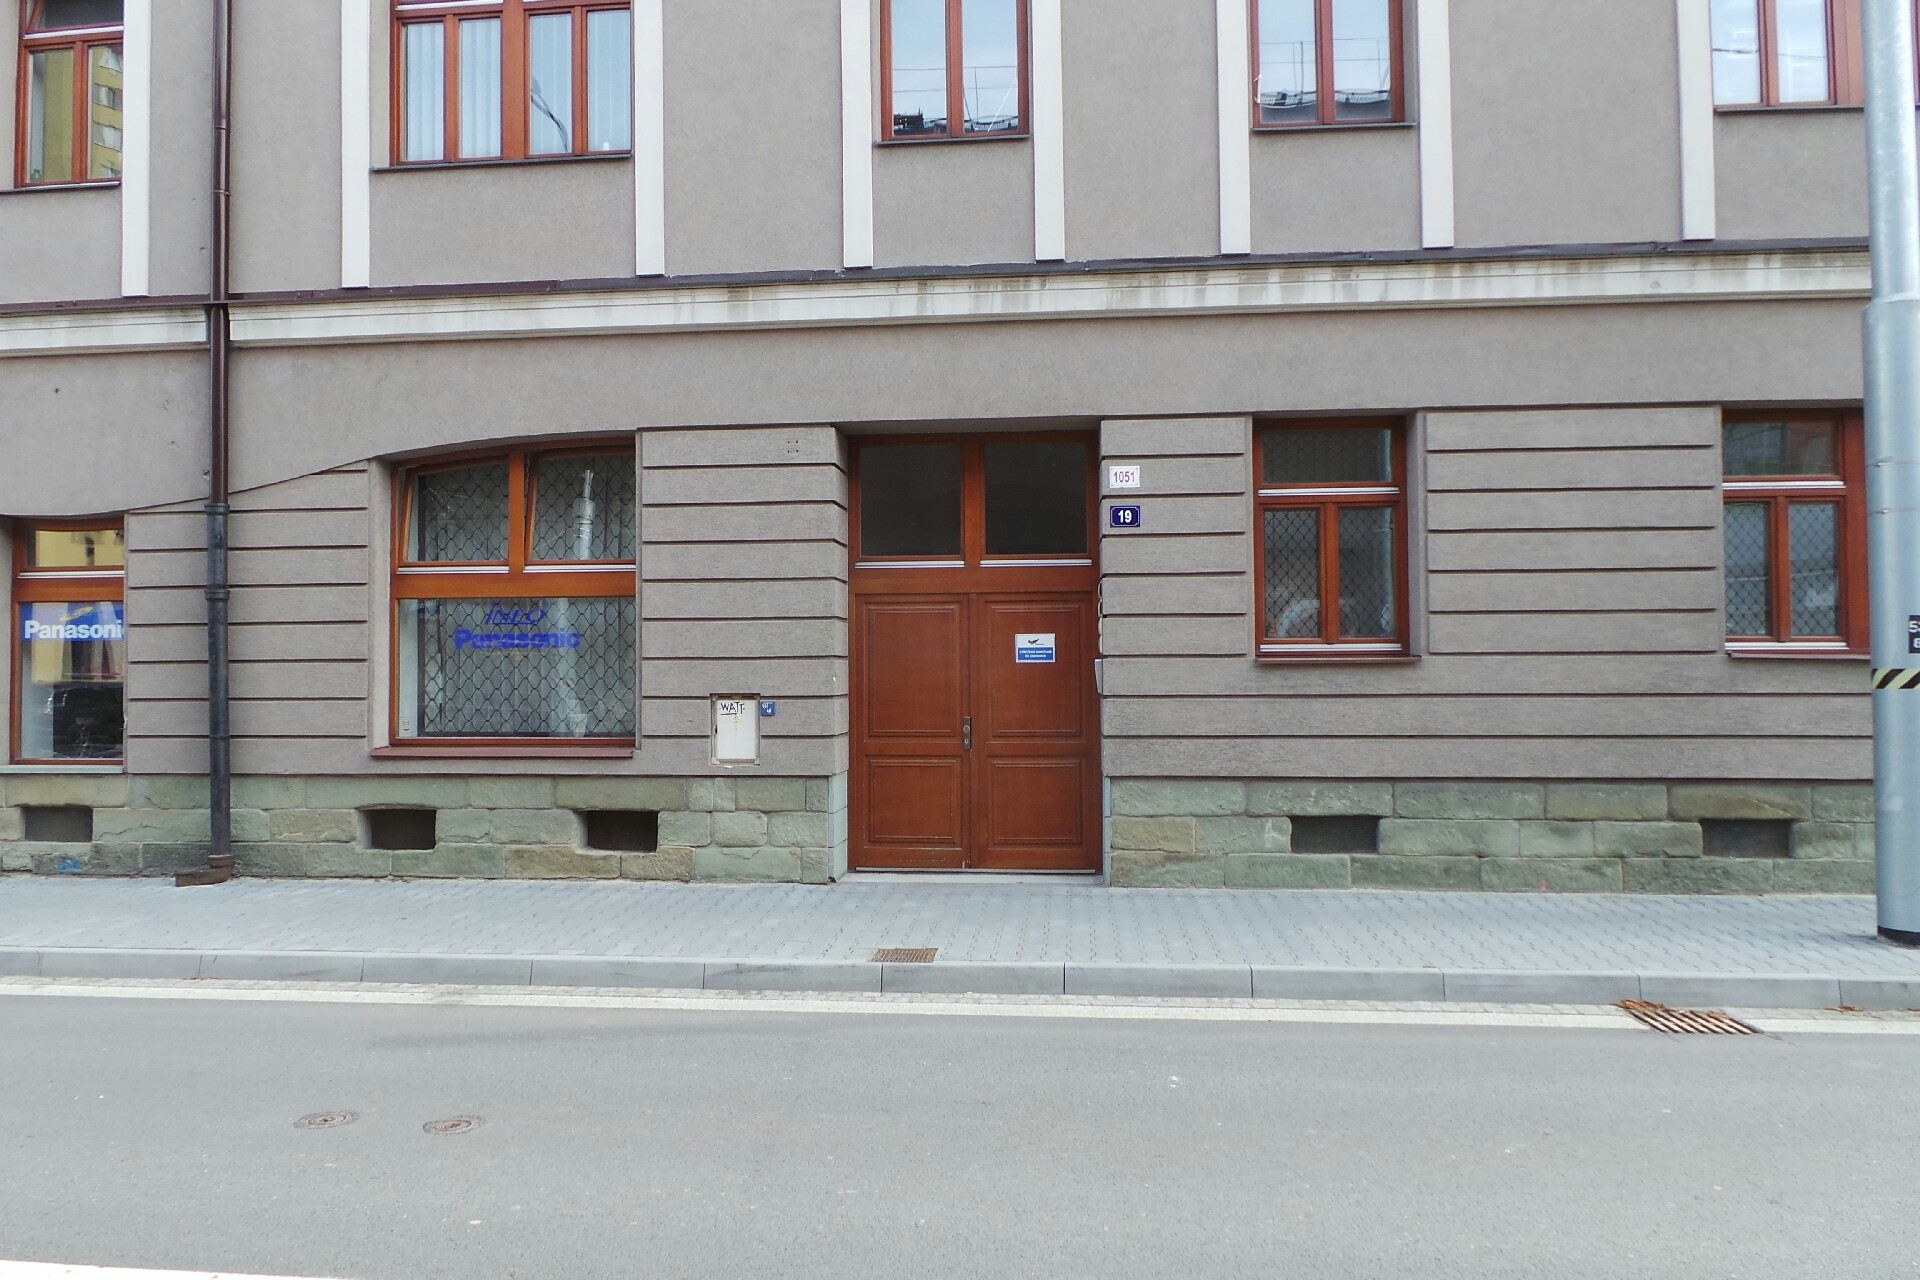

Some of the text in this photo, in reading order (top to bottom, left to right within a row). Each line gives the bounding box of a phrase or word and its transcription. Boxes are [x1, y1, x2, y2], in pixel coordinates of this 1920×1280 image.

[1114, 471, 1135, 483] 1051
[1118, 509, 1132, 523] 19
[24, 620, 125, 639] Panasoni
[454, 627, 581, 650] Panasonic
